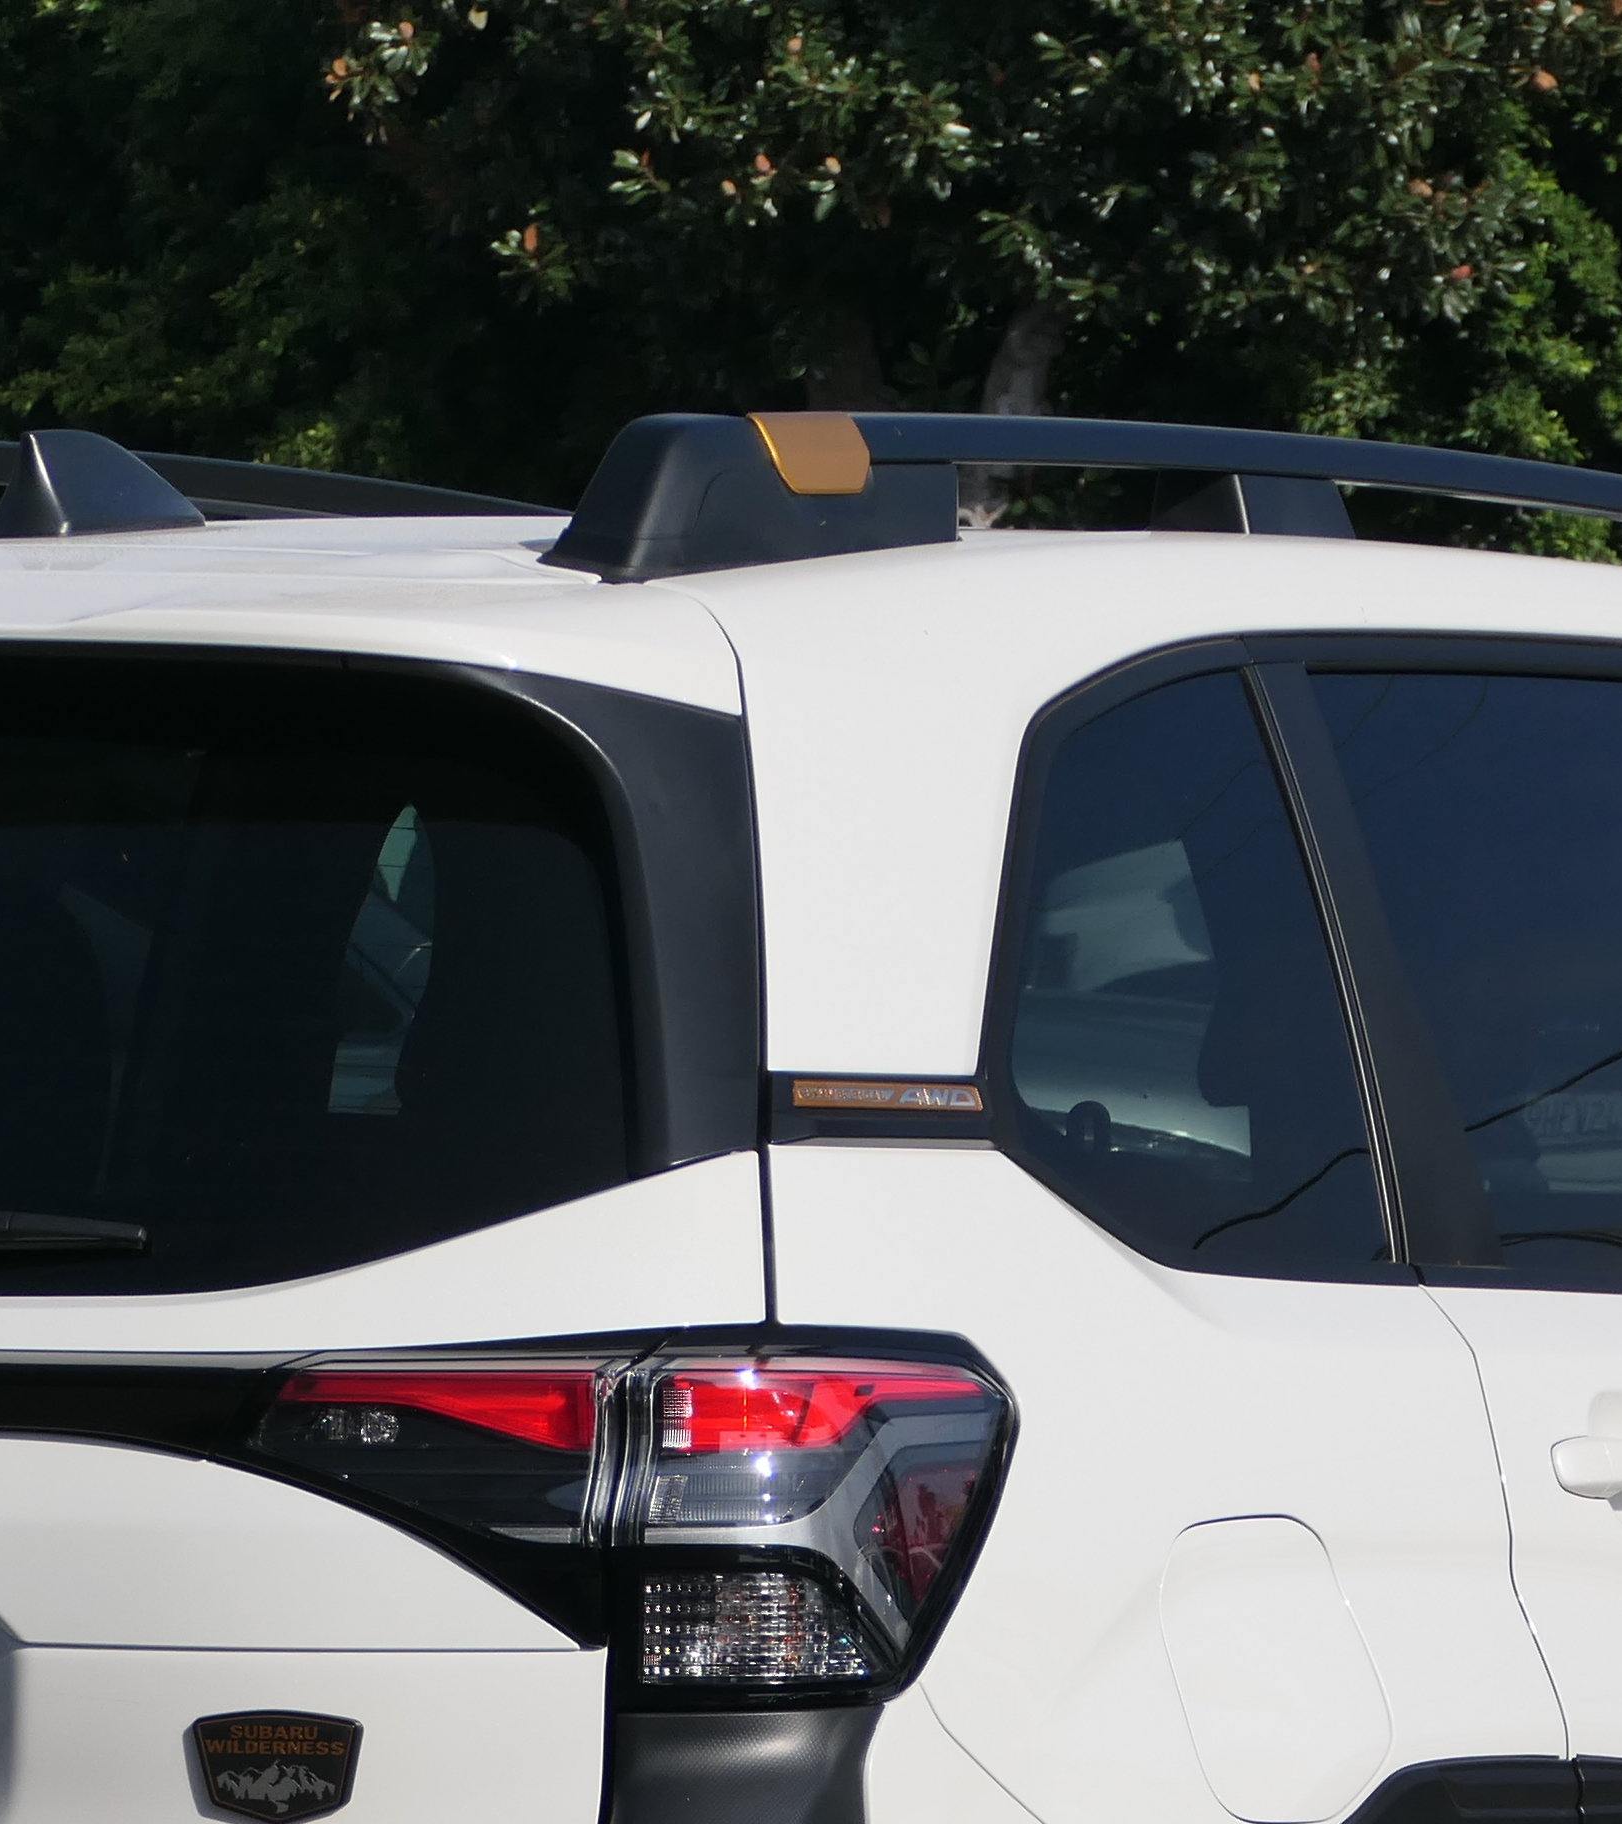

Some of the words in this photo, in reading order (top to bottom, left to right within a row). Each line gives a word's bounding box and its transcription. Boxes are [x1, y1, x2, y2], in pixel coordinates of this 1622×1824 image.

[899, 1087, 977, 1107] AWD
[230, 1725, 318, 1740] SUBARU
[205, 1740, 345, 1755] WILDERNESS
